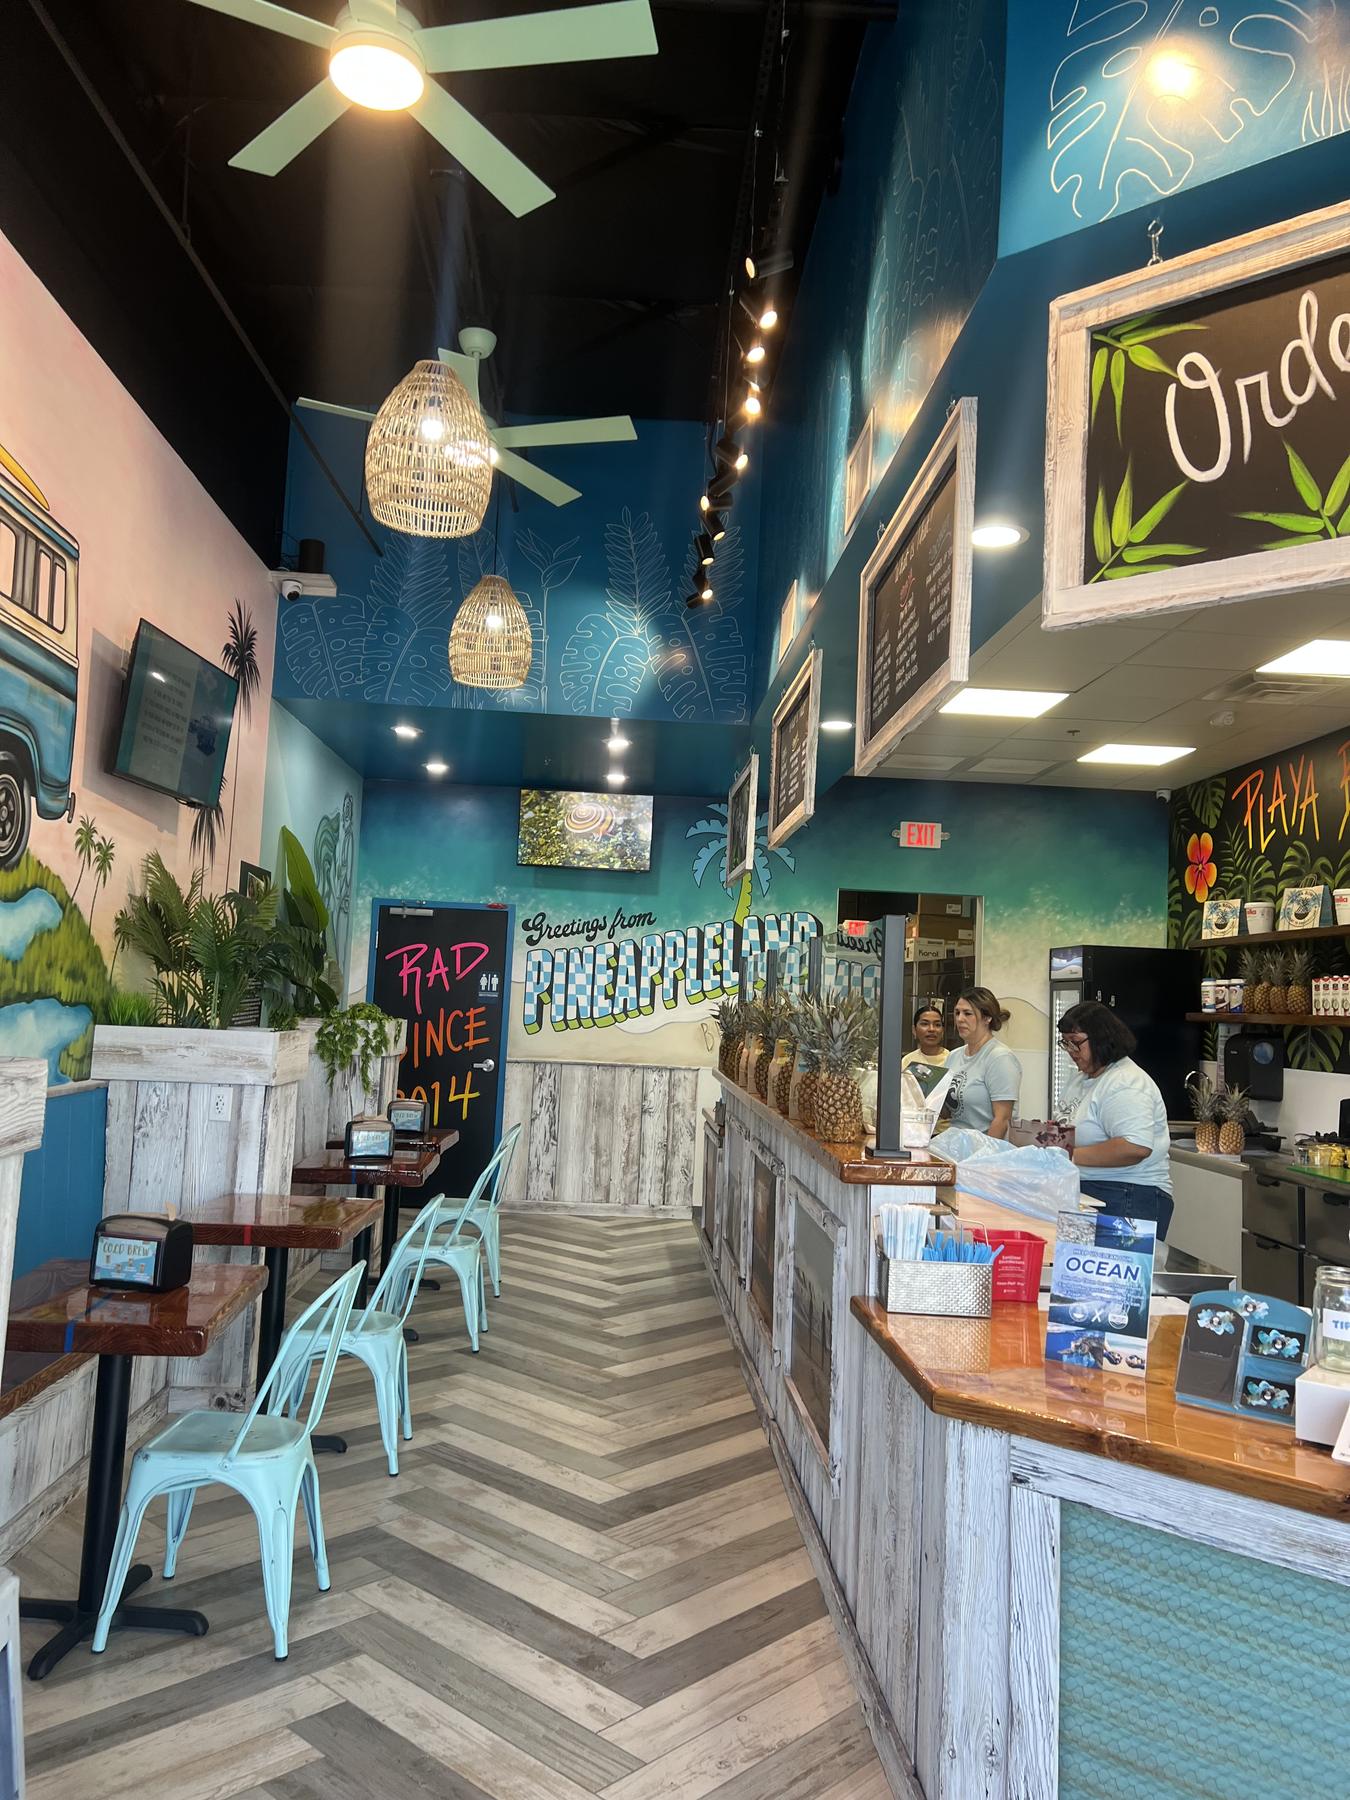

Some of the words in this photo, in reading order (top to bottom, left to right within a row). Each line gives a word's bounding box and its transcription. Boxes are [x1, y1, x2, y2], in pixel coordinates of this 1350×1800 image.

[1231, 754, 1320, 853] PLAYA
[907, 823, 936, 847] EXIT
[522, 911, 608, 947] Greetings
[610, 907, 657, 939] from
[385, 942, 490, 1015] RAD
[400, 1006, 491, 1069] INCE
[102, 1241, 125, 1256] COLD
[126, 1243, 150, 1257] BREW
[1066, 1257, 1140, 1281] OCEAN
